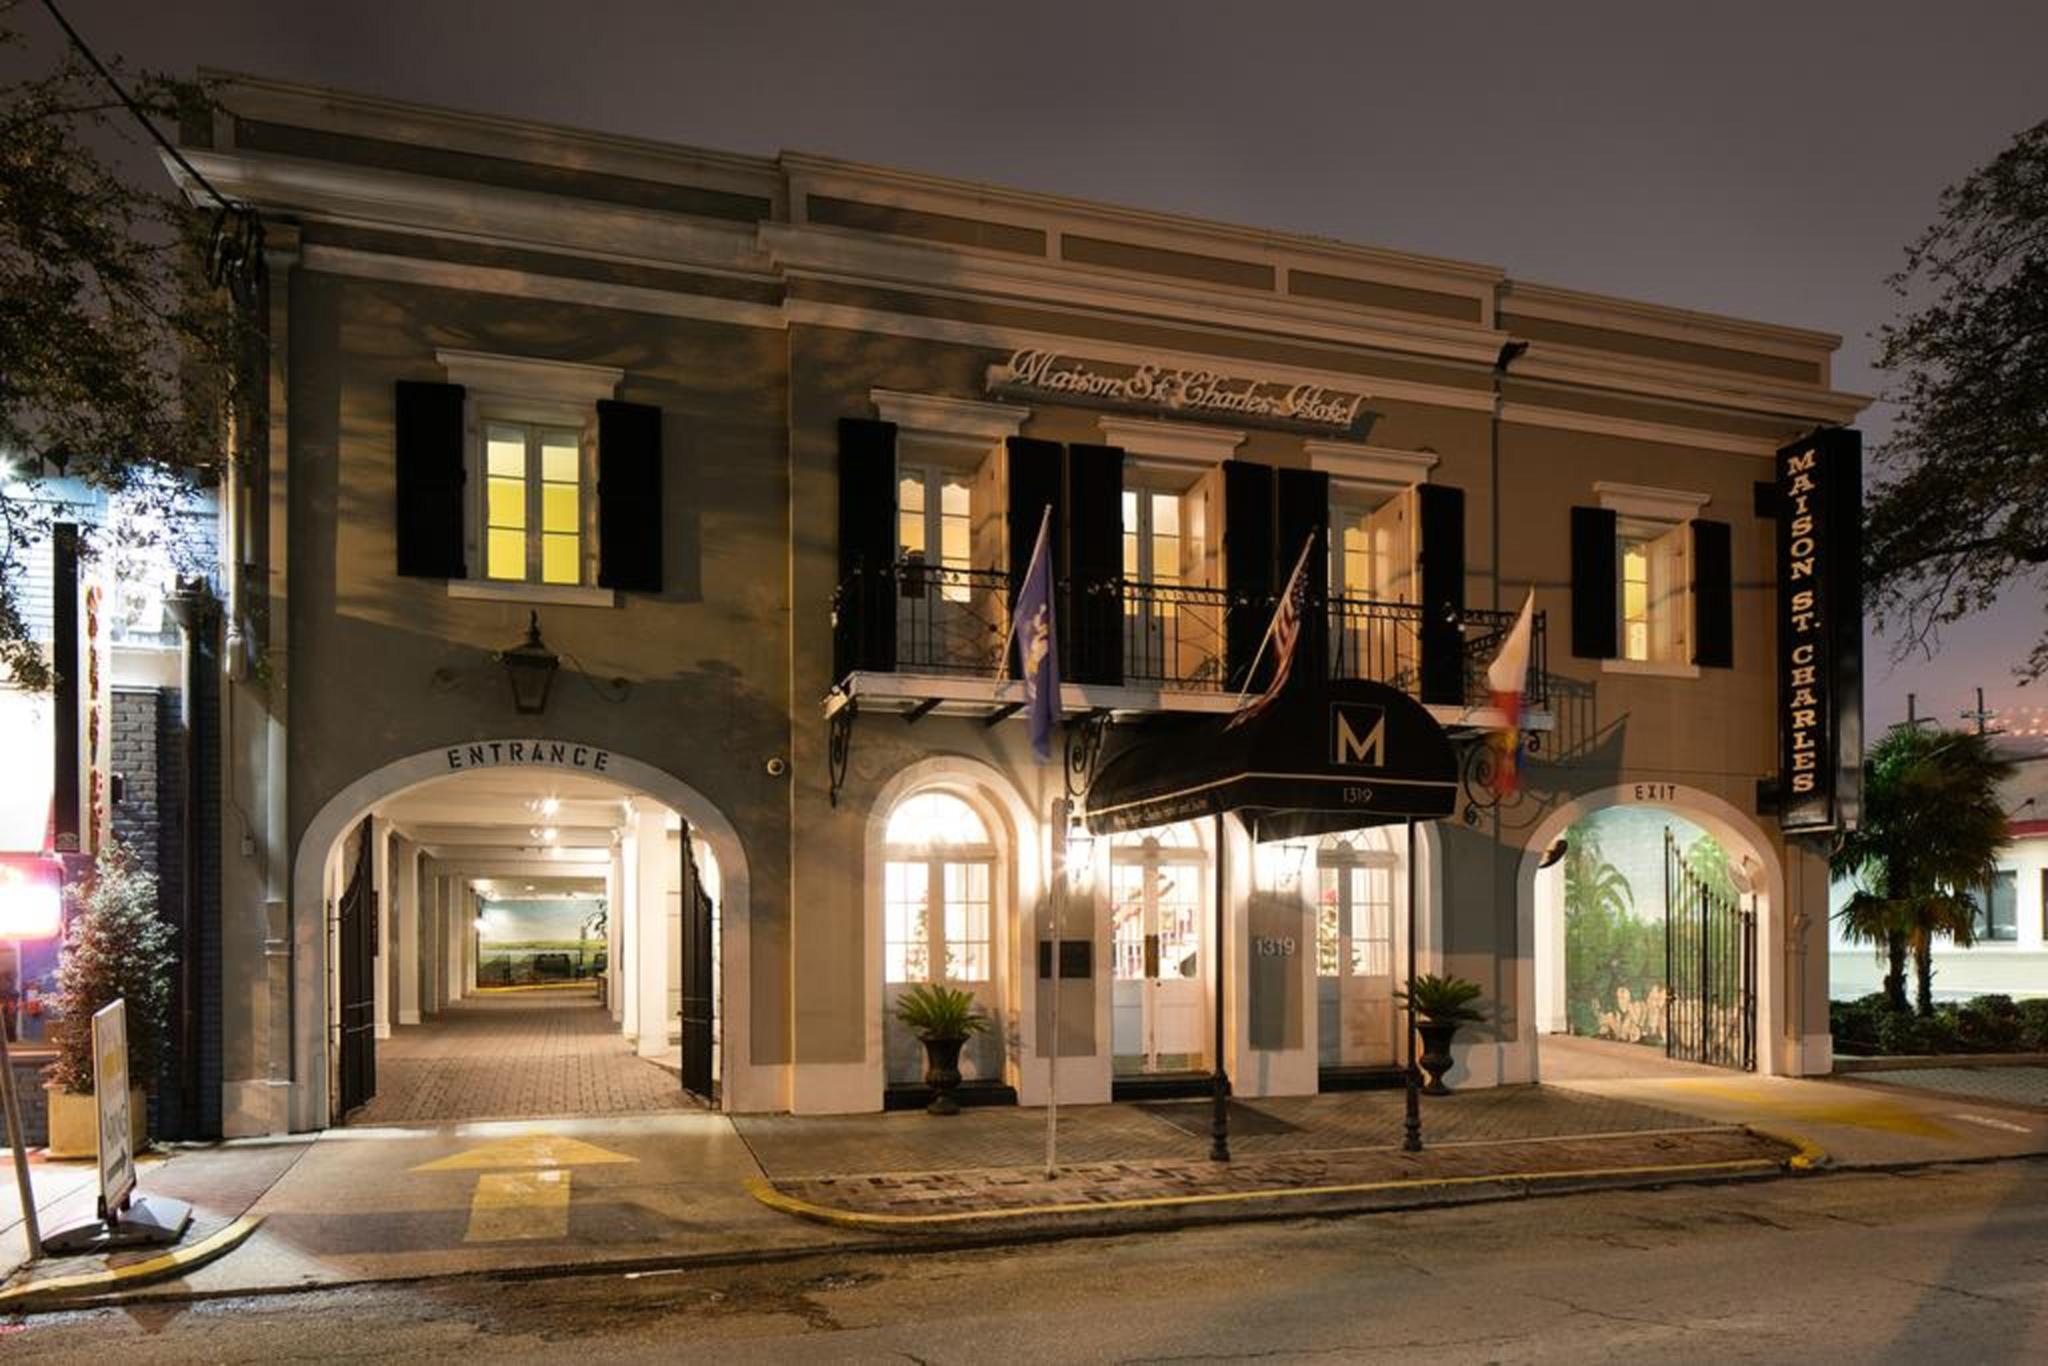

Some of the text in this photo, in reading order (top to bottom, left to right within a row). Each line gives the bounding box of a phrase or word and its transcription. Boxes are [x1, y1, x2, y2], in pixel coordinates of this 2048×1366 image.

[1008, 350, 1122, 396] Maison
[1172, 369, 1276, 413] Charles
[1278, 384, 1362, 425] Hotel
[1787, 449, 1821, 793] MAISON ST. CHARLES
[1337, 710, 1385, 767] M
[448, 742, 609, 771] ENTRANCE
[1343, 786, 1373, 803] 1319
[1635, 784, 1676, 801] EXIT
[1256, 936, 1295, 957] 1319
